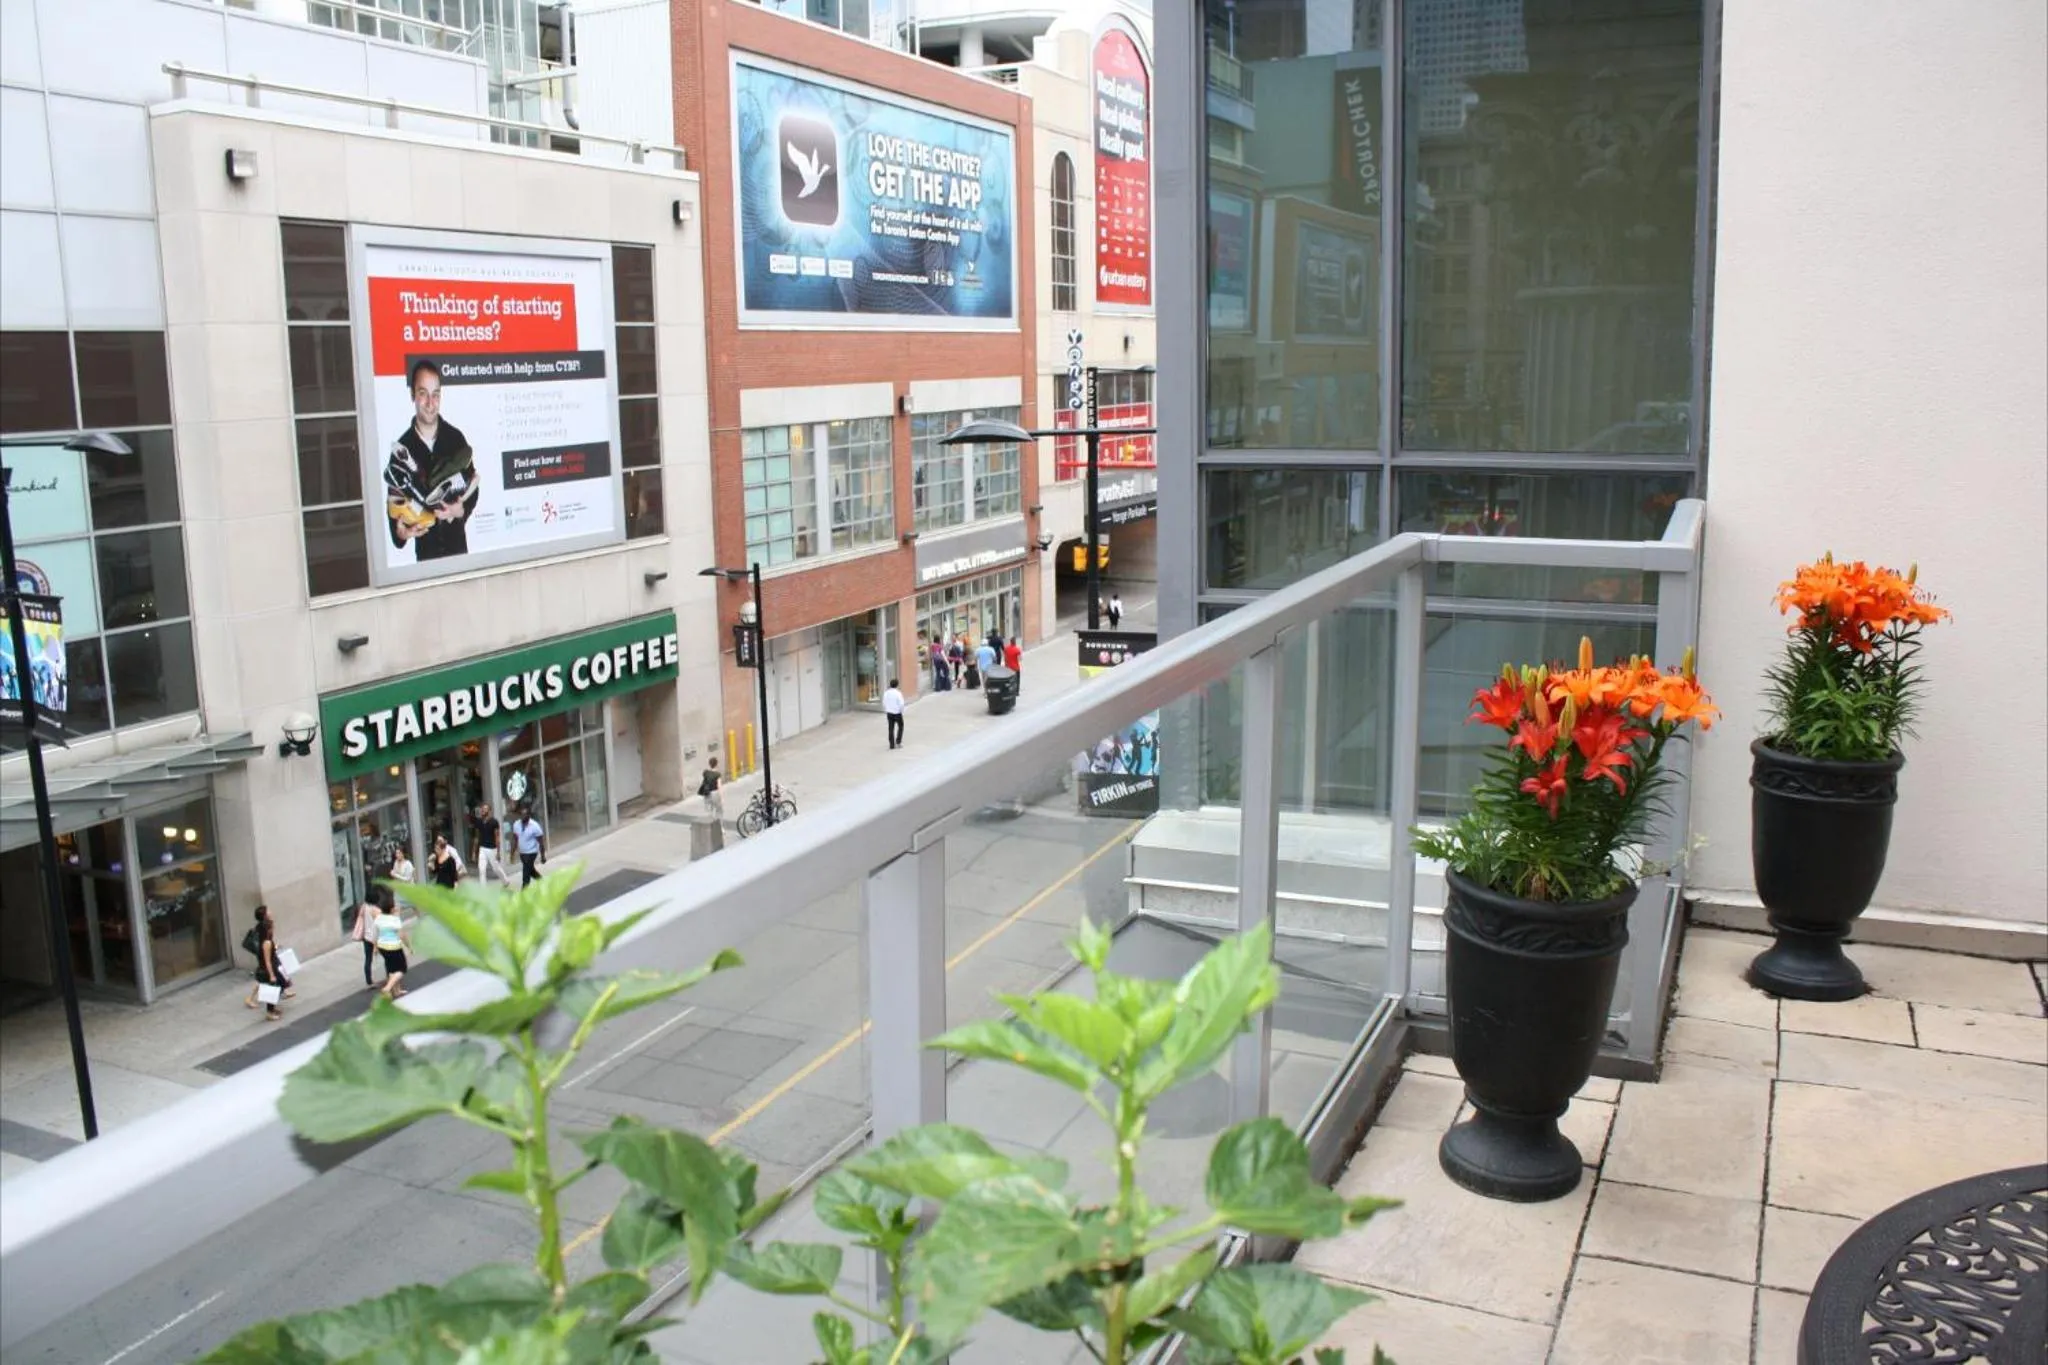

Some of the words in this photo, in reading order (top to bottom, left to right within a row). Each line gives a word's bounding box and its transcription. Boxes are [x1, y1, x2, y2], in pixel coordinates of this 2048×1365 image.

[1097, 70, 1116, 99] Real
[1100, 98, 1118, 127] Real
[868, 132, 904, 163] LOVE
[906, 141, 929, 167] THE
[932, 147, 981, 178] CENTRE?
[1100, 126, 1124, 158] Really
[869, 161, 906, 200] GET
[910, 169, 944, 206] THE
[948, 177, 981, 211] APP
[870, 205, 885, 218] Find
[886, 209, 912, 223] yourself
[913, 213, 921, 223] at
[921, 212, 932, 225] the
[932, 213, 948, 228] heart
[969, 220, 983, 232] with
[871, 220, 882, 234] the
[883, 222, 908, 237] Toronto
[908, 226, 927, 239] Eaton
[927, 228, 947, 242] Centre
[947, 231, 960, 247] App
[400, 291, 479, 320] Thinking
[483, 295, 499, 315] of
[502, 296, 562, 320] starting
[403, 328, 414, 341] a
[418, 320, 501, 342] business?
[441, 363, 460, 377] Get
[460, 363, 493, 377] started
[493, 362, 513, 375] with
[514, 362, 535, 377] help
[535, 360, 555, 373] from
[514, 457, 529, 469] Find
[529, 457, 541, 467] out
[541, 455, 555, 466] how
[514, 473, 523, 481] or
[523, 470, 536, 480] call
[1112, 511, 1128, 525] Yonge
[1127, 505, 1148, 520] Parkade
[343, 663, 564, 757] STARBUCKS
[571, 633, 679, 691] COFFEE
[1090, 781, 1128, 807] FIRKIN
